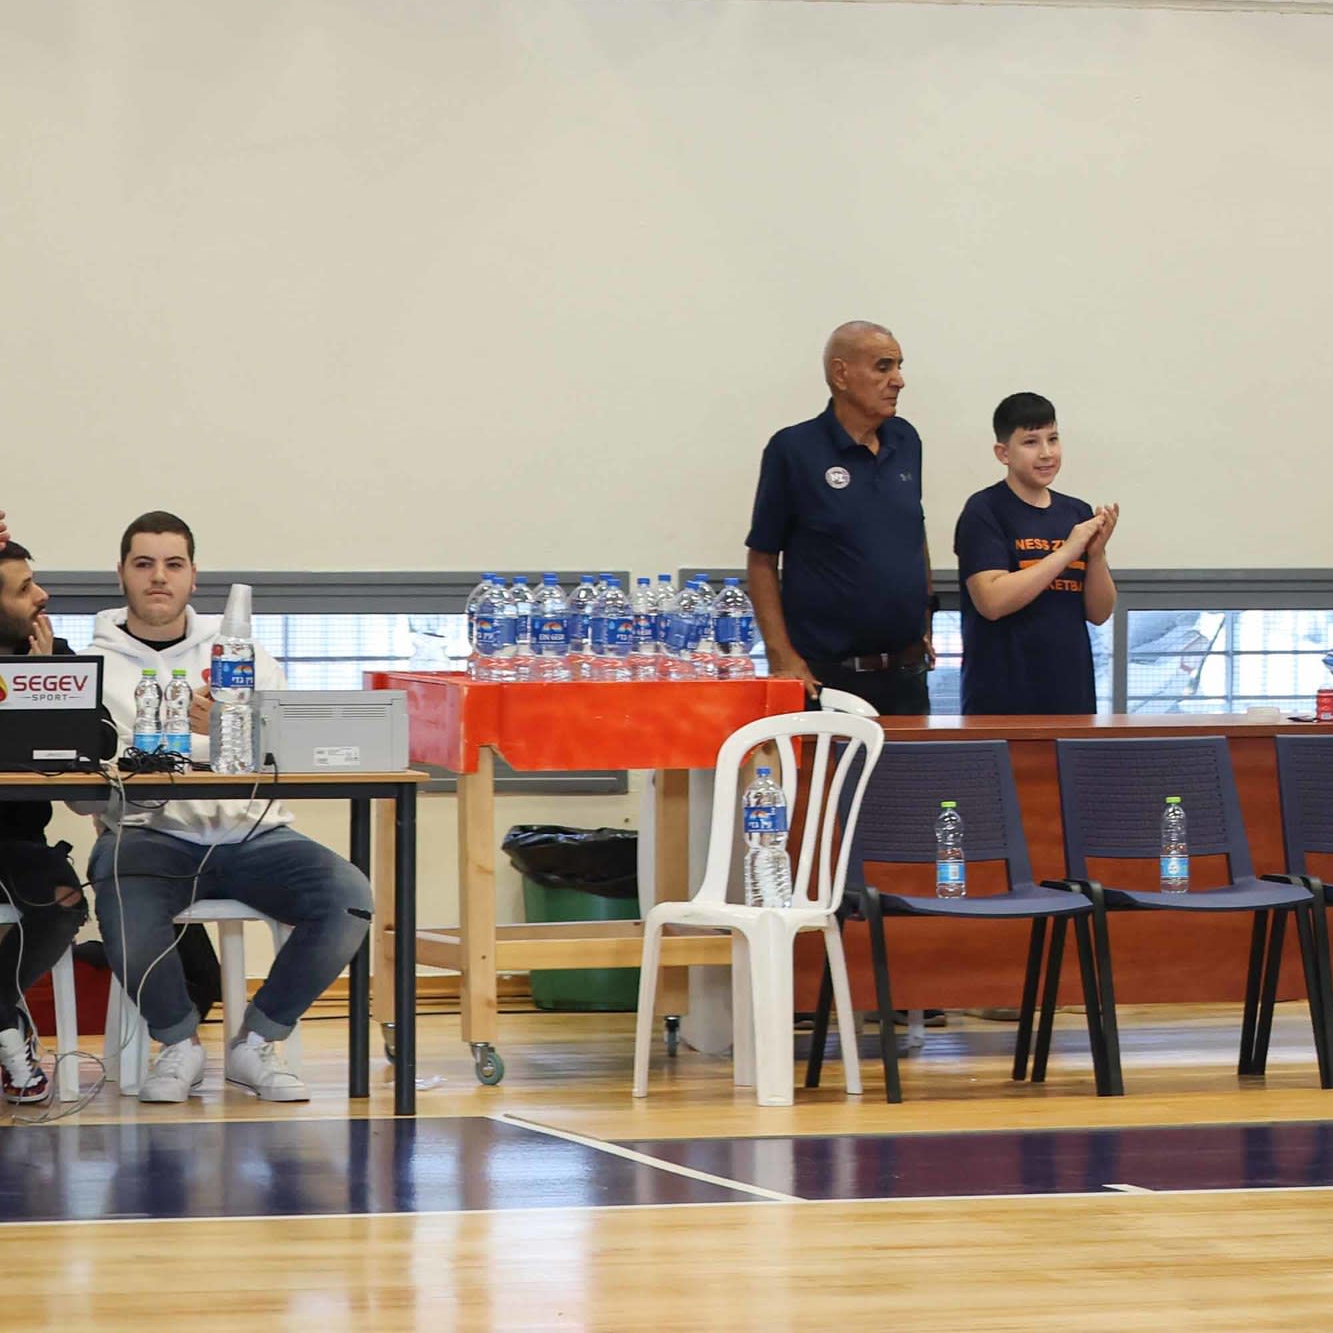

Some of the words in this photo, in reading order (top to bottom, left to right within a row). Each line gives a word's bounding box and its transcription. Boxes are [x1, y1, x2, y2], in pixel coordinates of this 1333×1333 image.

[1015, 538, 1050, 551] NESS
[13, 675, 88, 692] SEGEV
[32, 694, 68, 702] SPORT
